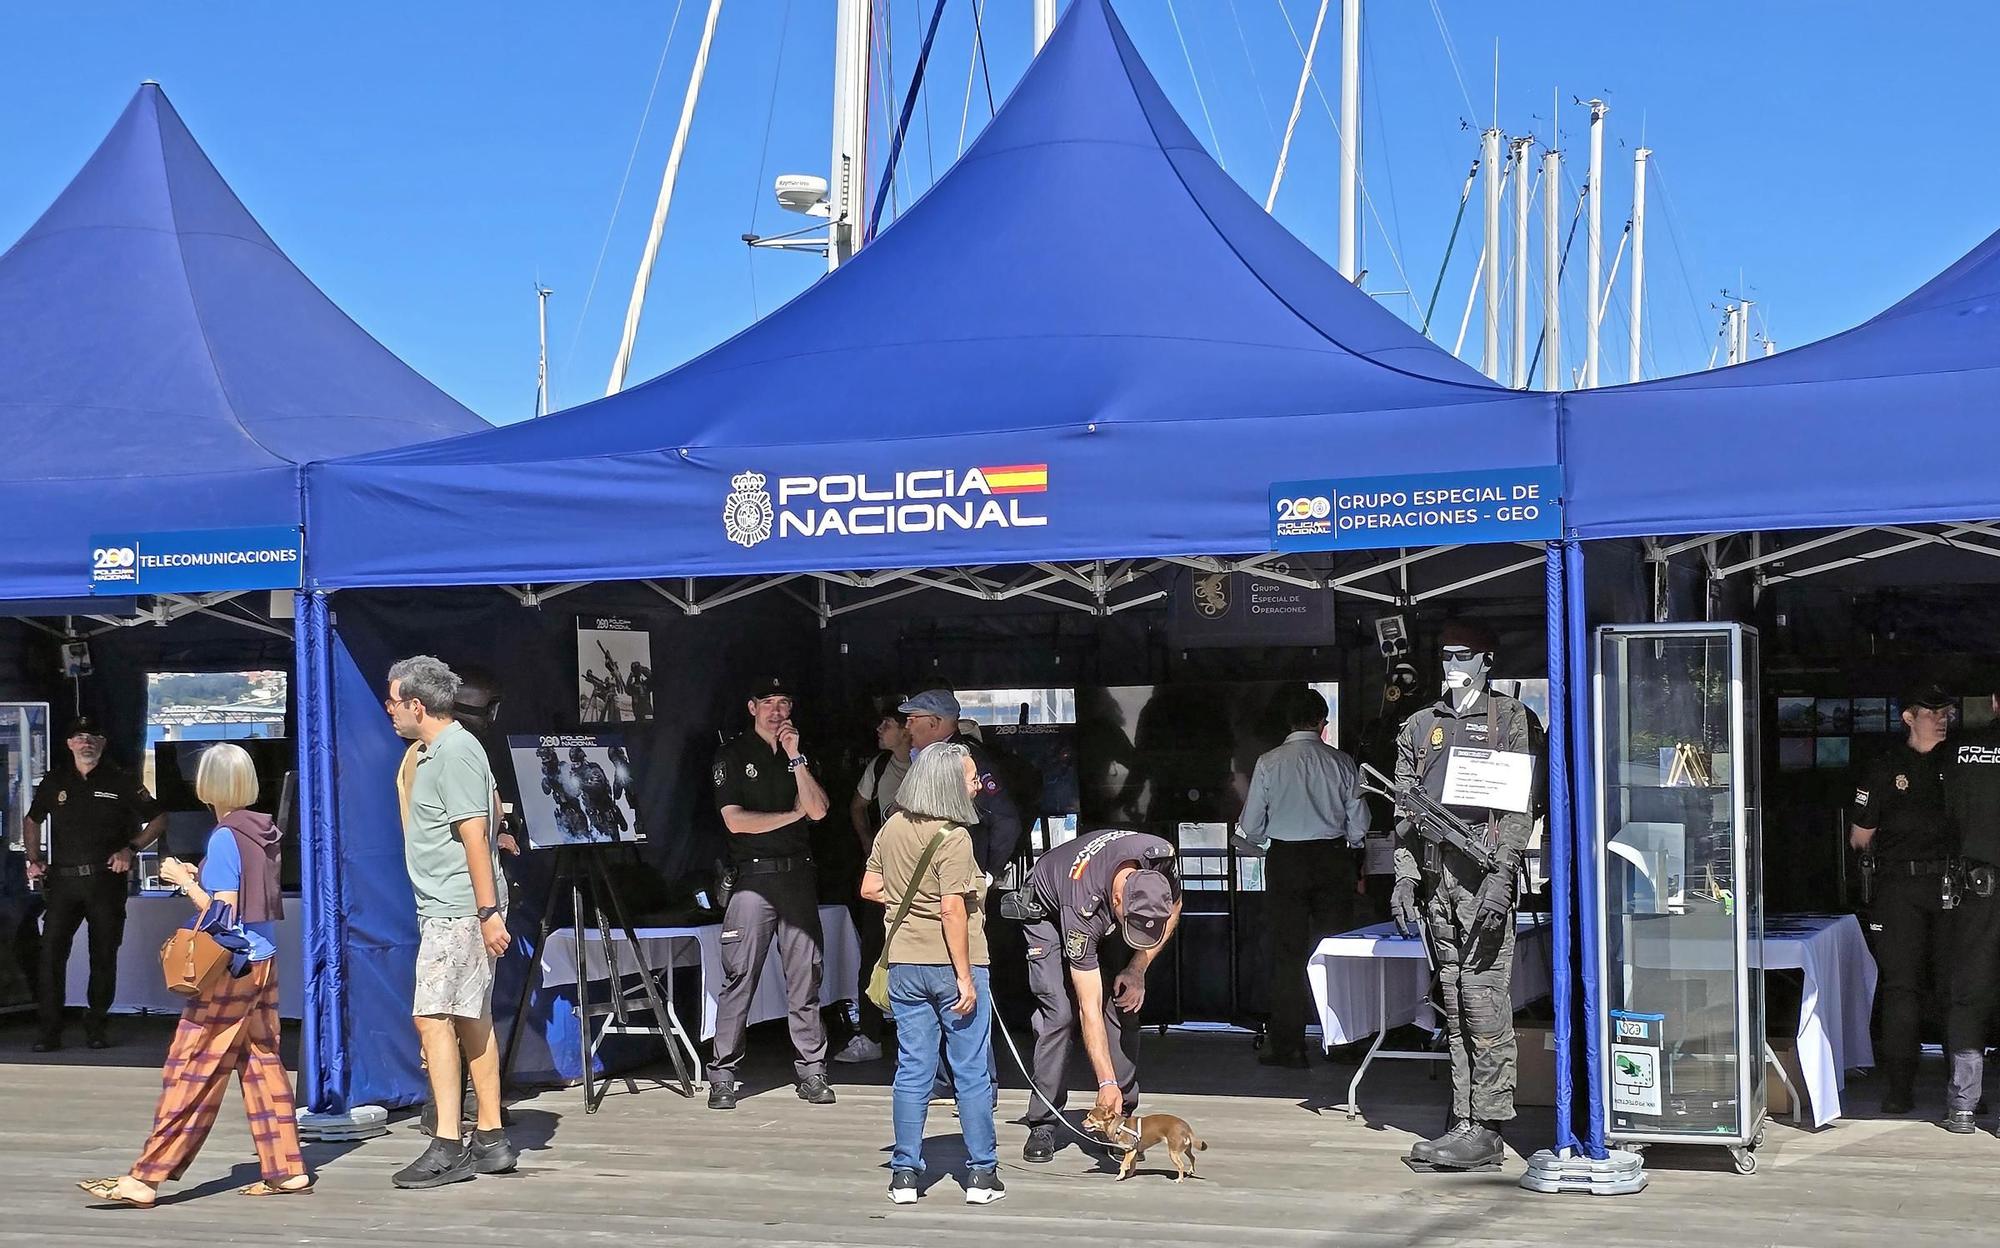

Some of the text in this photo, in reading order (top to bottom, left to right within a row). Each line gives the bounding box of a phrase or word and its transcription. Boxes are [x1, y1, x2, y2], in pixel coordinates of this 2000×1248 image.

[1338, 484, 1540, 510] GRUPO ESPECIAL DE
[779, 499, 1048, 538] NACIONAL
[1276, 497, 1331, 521] 200
[1339, 508, 1478, 530] OPERACIONES
[1496, 505, 1539, 522] GEO
[1277, 527, 1332, 536] NACIONAL
[93, 547, 135, 569] 200
[140, 549, 297, 568] TELECOMUNICACIONES
[539, 735, 560, 747] 200
[1958, 746, 2000, 755] POLI
